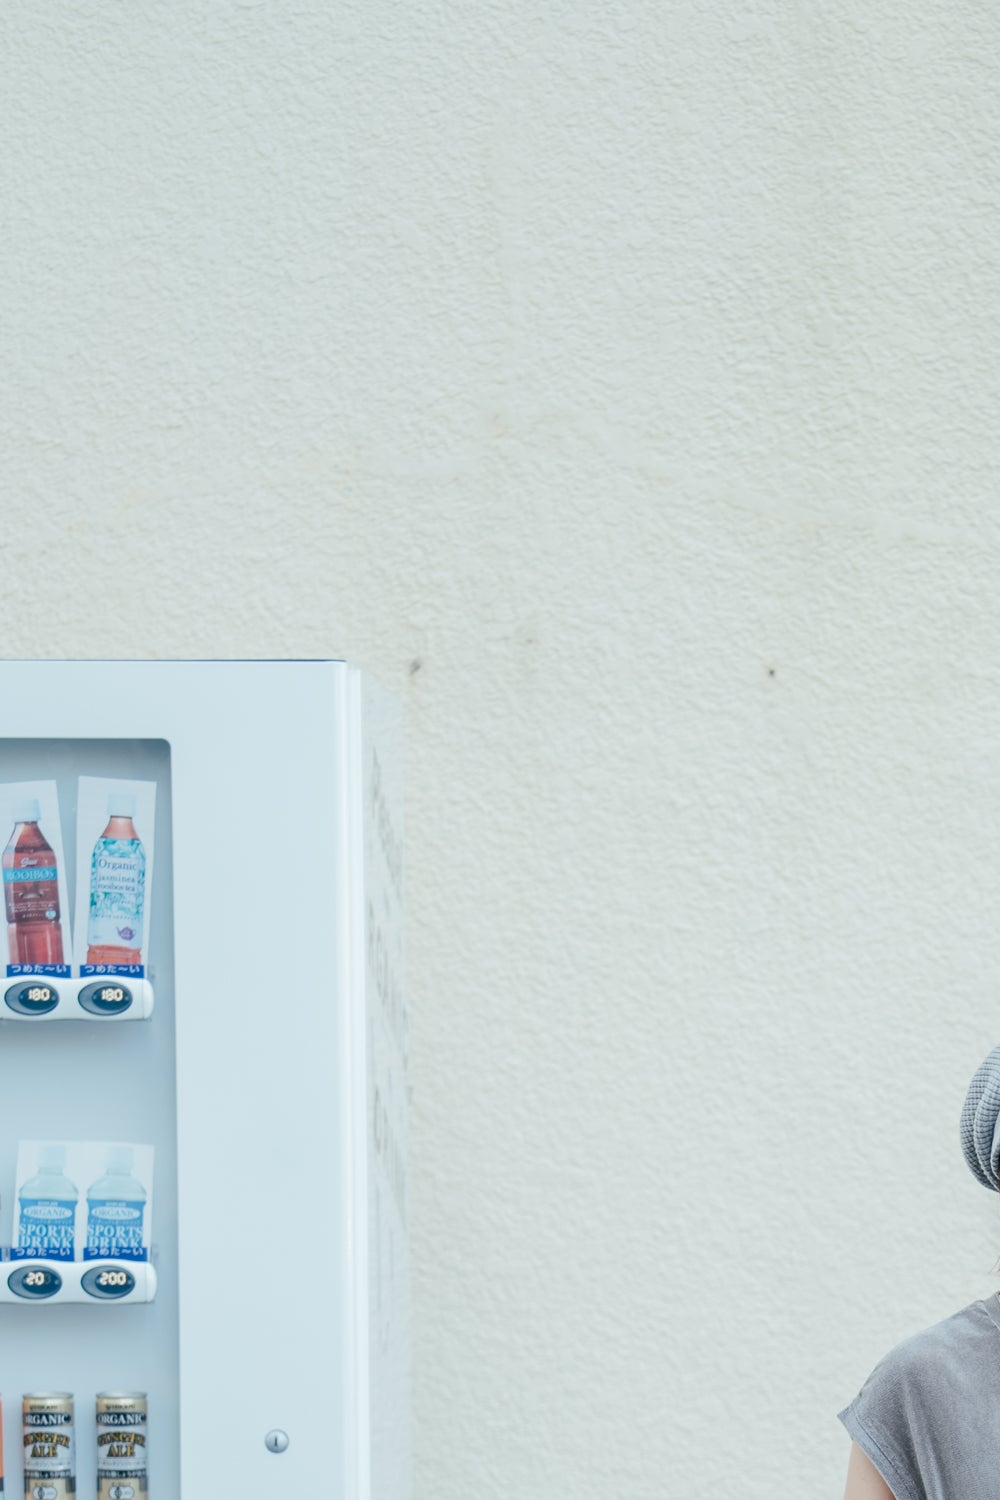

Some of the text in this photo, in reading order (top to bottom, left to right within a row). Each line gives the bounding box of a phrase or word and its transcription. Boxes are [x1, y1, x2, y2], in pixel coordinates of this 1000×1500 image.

[18, 1223, 75, 1238] SPORTS
[87, 1224, 143, 1238] SPORTS
[20, 1236, 72, 1248] DRINK
[89, 1236, 139, 1248] DRINK
[99, 1272, 126, 1285] 200
[30, 1444, 58, 1457] ALE
[106, 1444, 135, 1457] ALE
